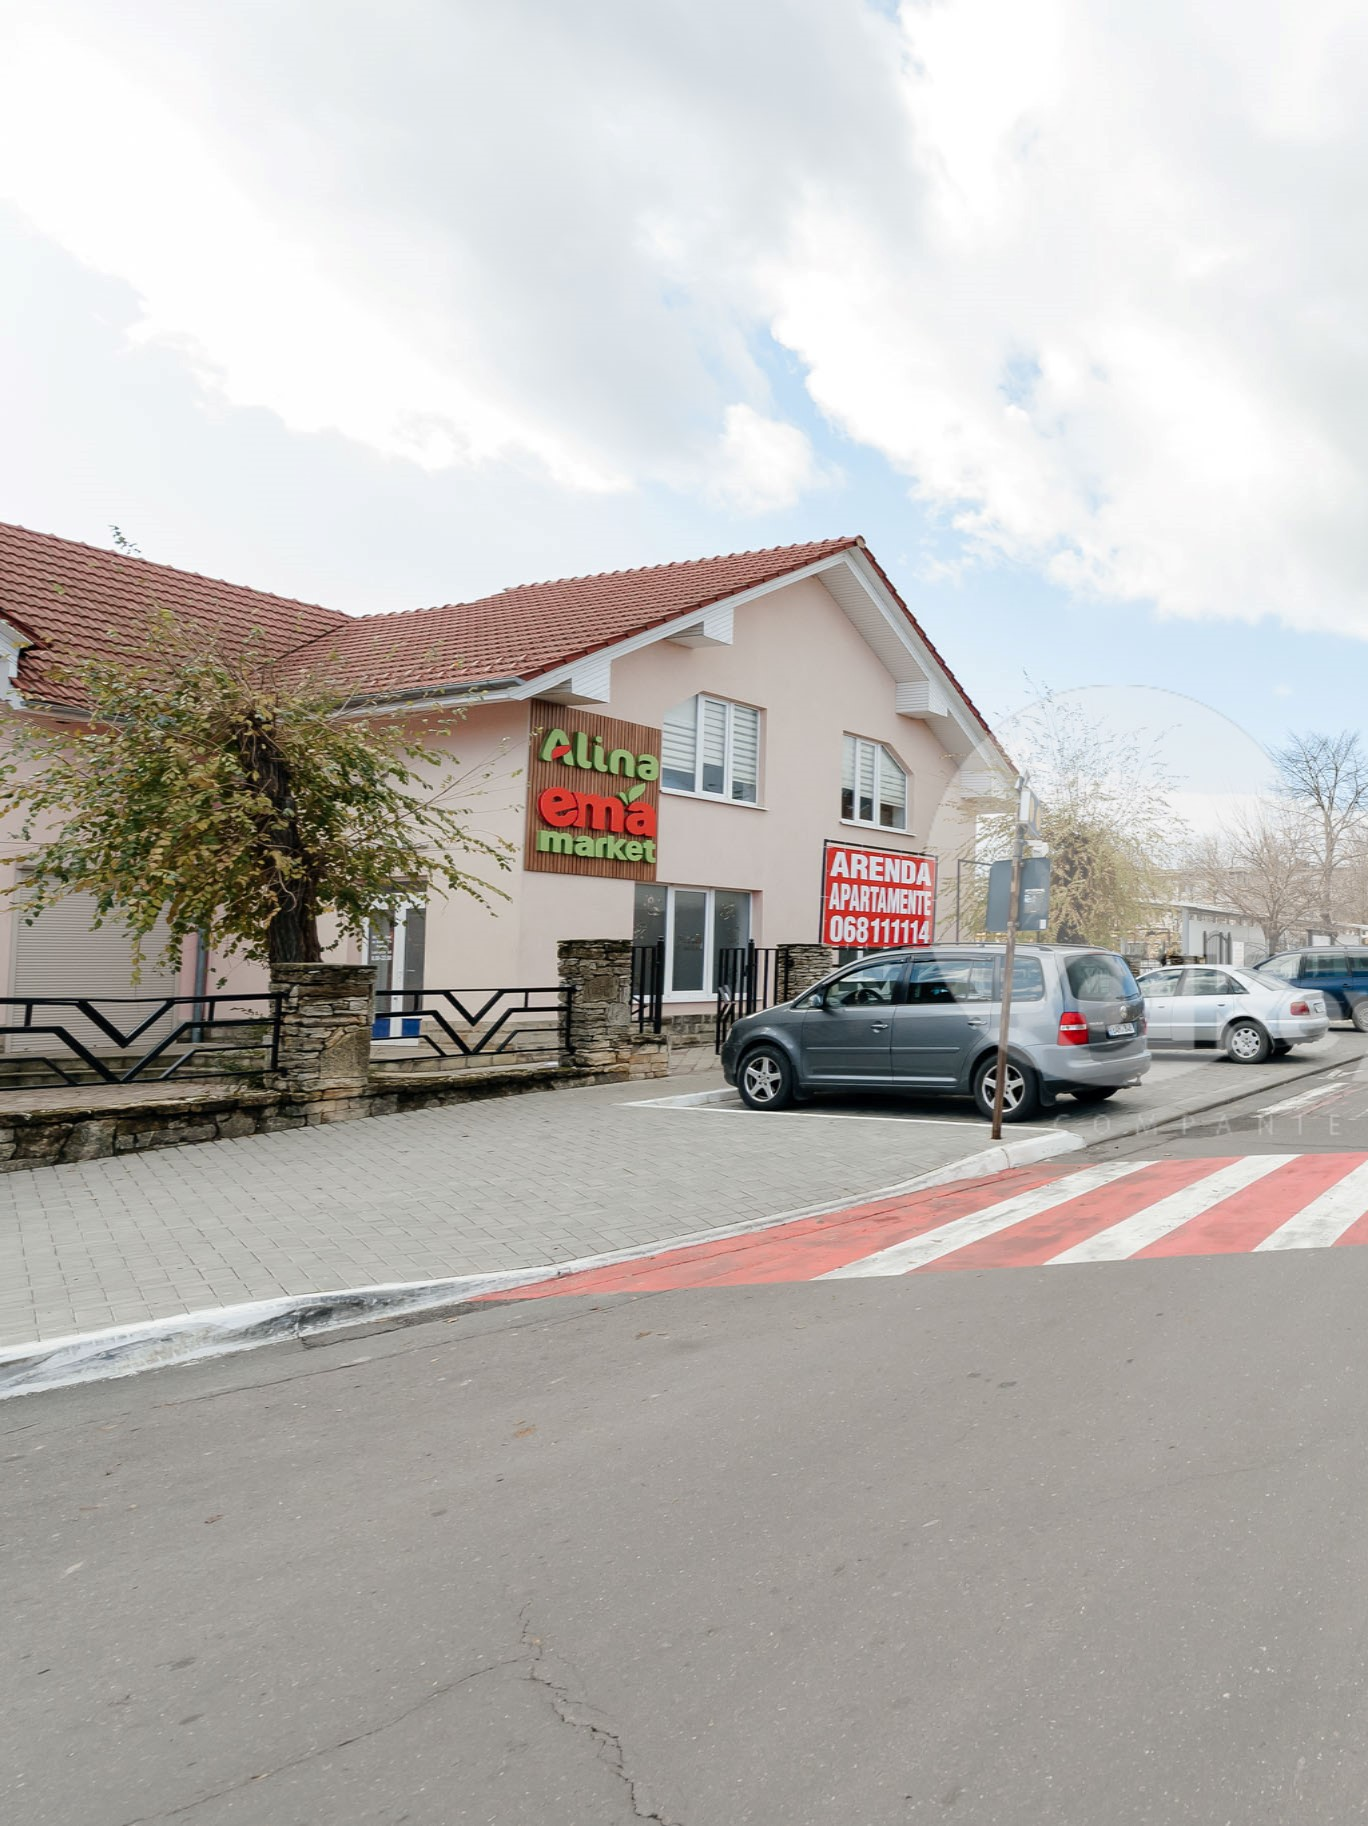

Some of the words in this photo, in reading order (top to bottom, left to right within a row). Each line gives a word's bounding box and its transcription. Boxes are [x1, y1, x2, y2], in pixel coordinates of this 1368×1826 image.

[539, 728, 660, 781] Alina
[538, 787, 657, 837] ema
[537, 829, 657, 863] market
[829, 851, 932, 887] ARENDA
[828, 882, 932, 916] APARTAMENTE
[829, 915, 930, 944] 068111114
